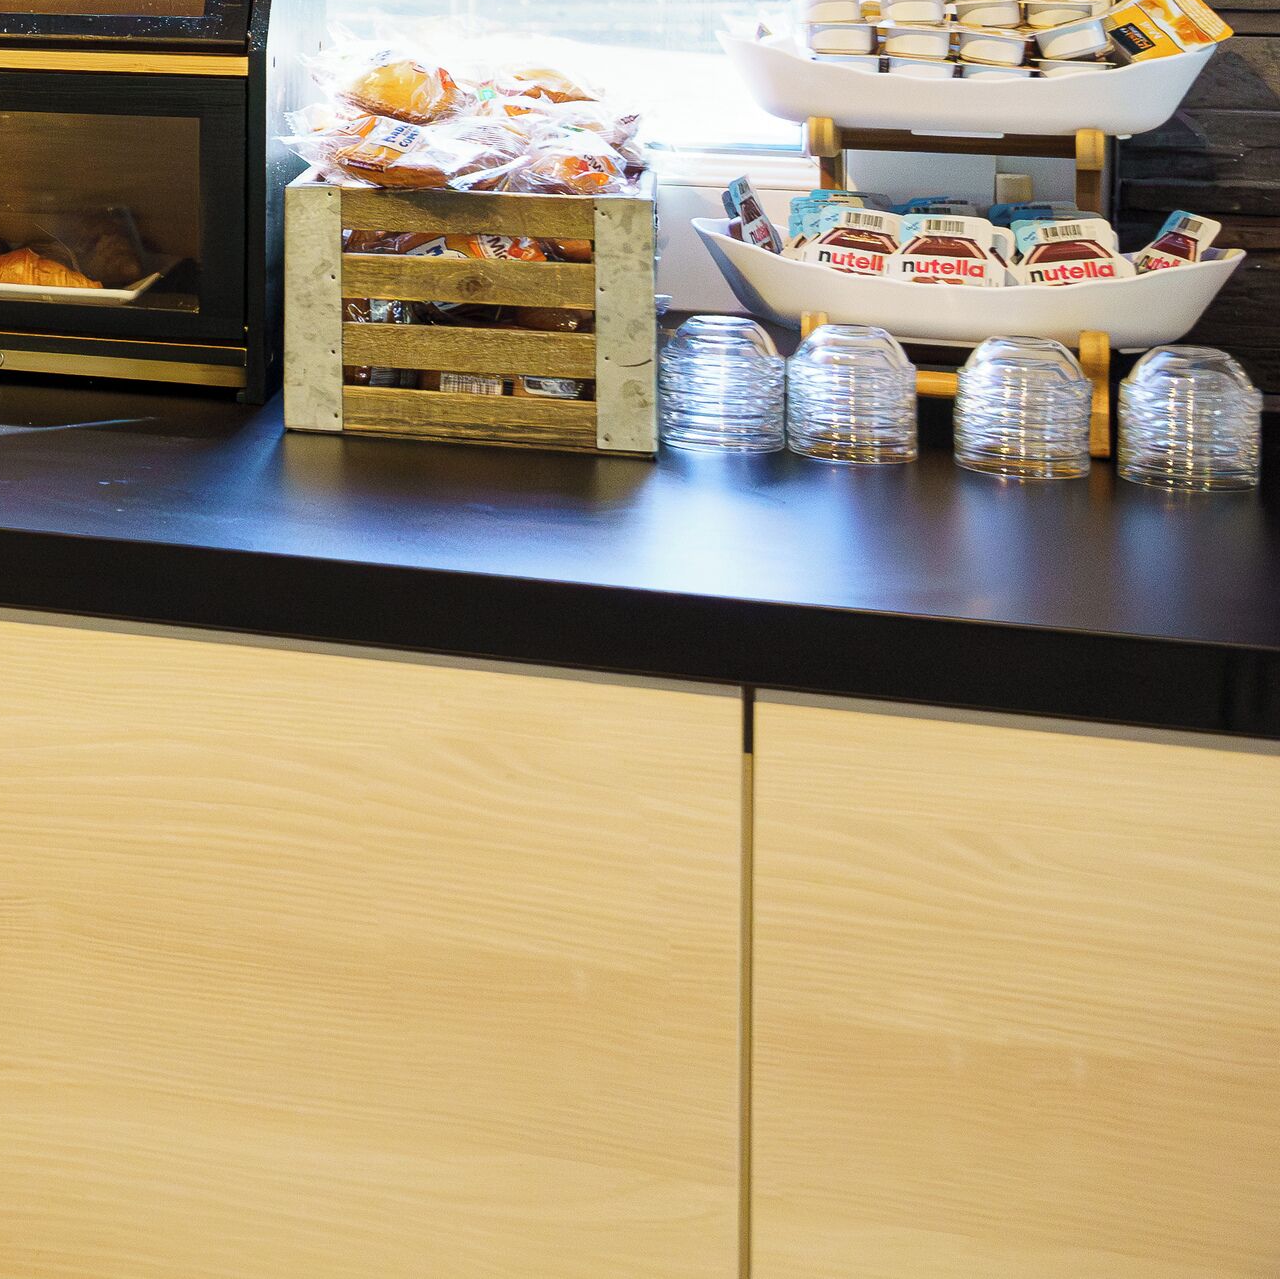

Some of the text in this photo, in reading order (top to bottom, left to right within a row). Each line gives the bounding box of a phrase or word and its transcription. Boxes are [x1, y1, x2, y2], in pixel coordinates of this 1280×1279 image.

[818, 250, 884, 272] nutell
[902, 259, 985, 278] nutella
[1030, 261, 1115, 283] nutella
